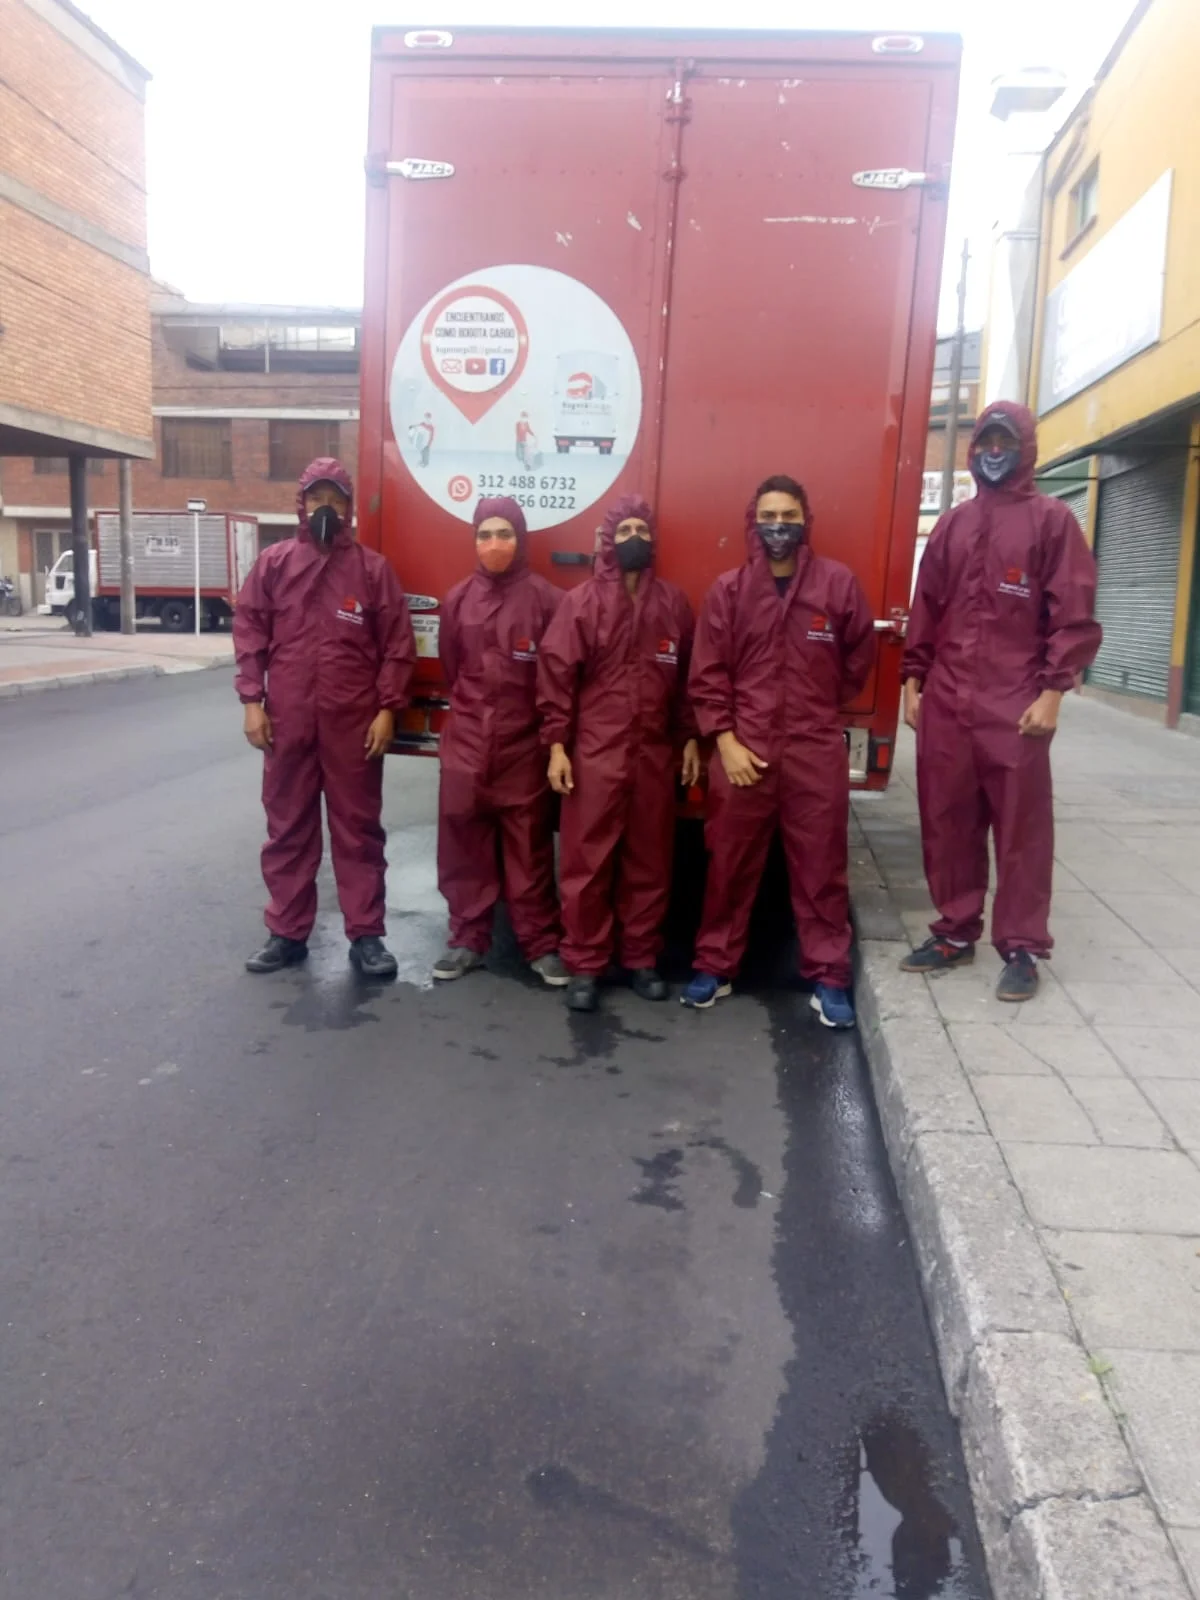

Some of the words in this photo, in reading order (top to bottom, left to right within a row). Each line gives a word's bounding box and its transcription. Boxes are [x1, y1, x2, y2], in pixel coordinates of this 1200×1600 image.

[411, 163, 445, 174] JAC
[863, 172, 898, 184] JAC
[435, 327, 457, 338] COMO
[489, 328, 515, 339] CARGO
[478, 474, 504, 489] 312
[508, 475, 536, 489] 488
[540, 476, 576, 490] 6732
[539, 495, 576, 509] 0222
